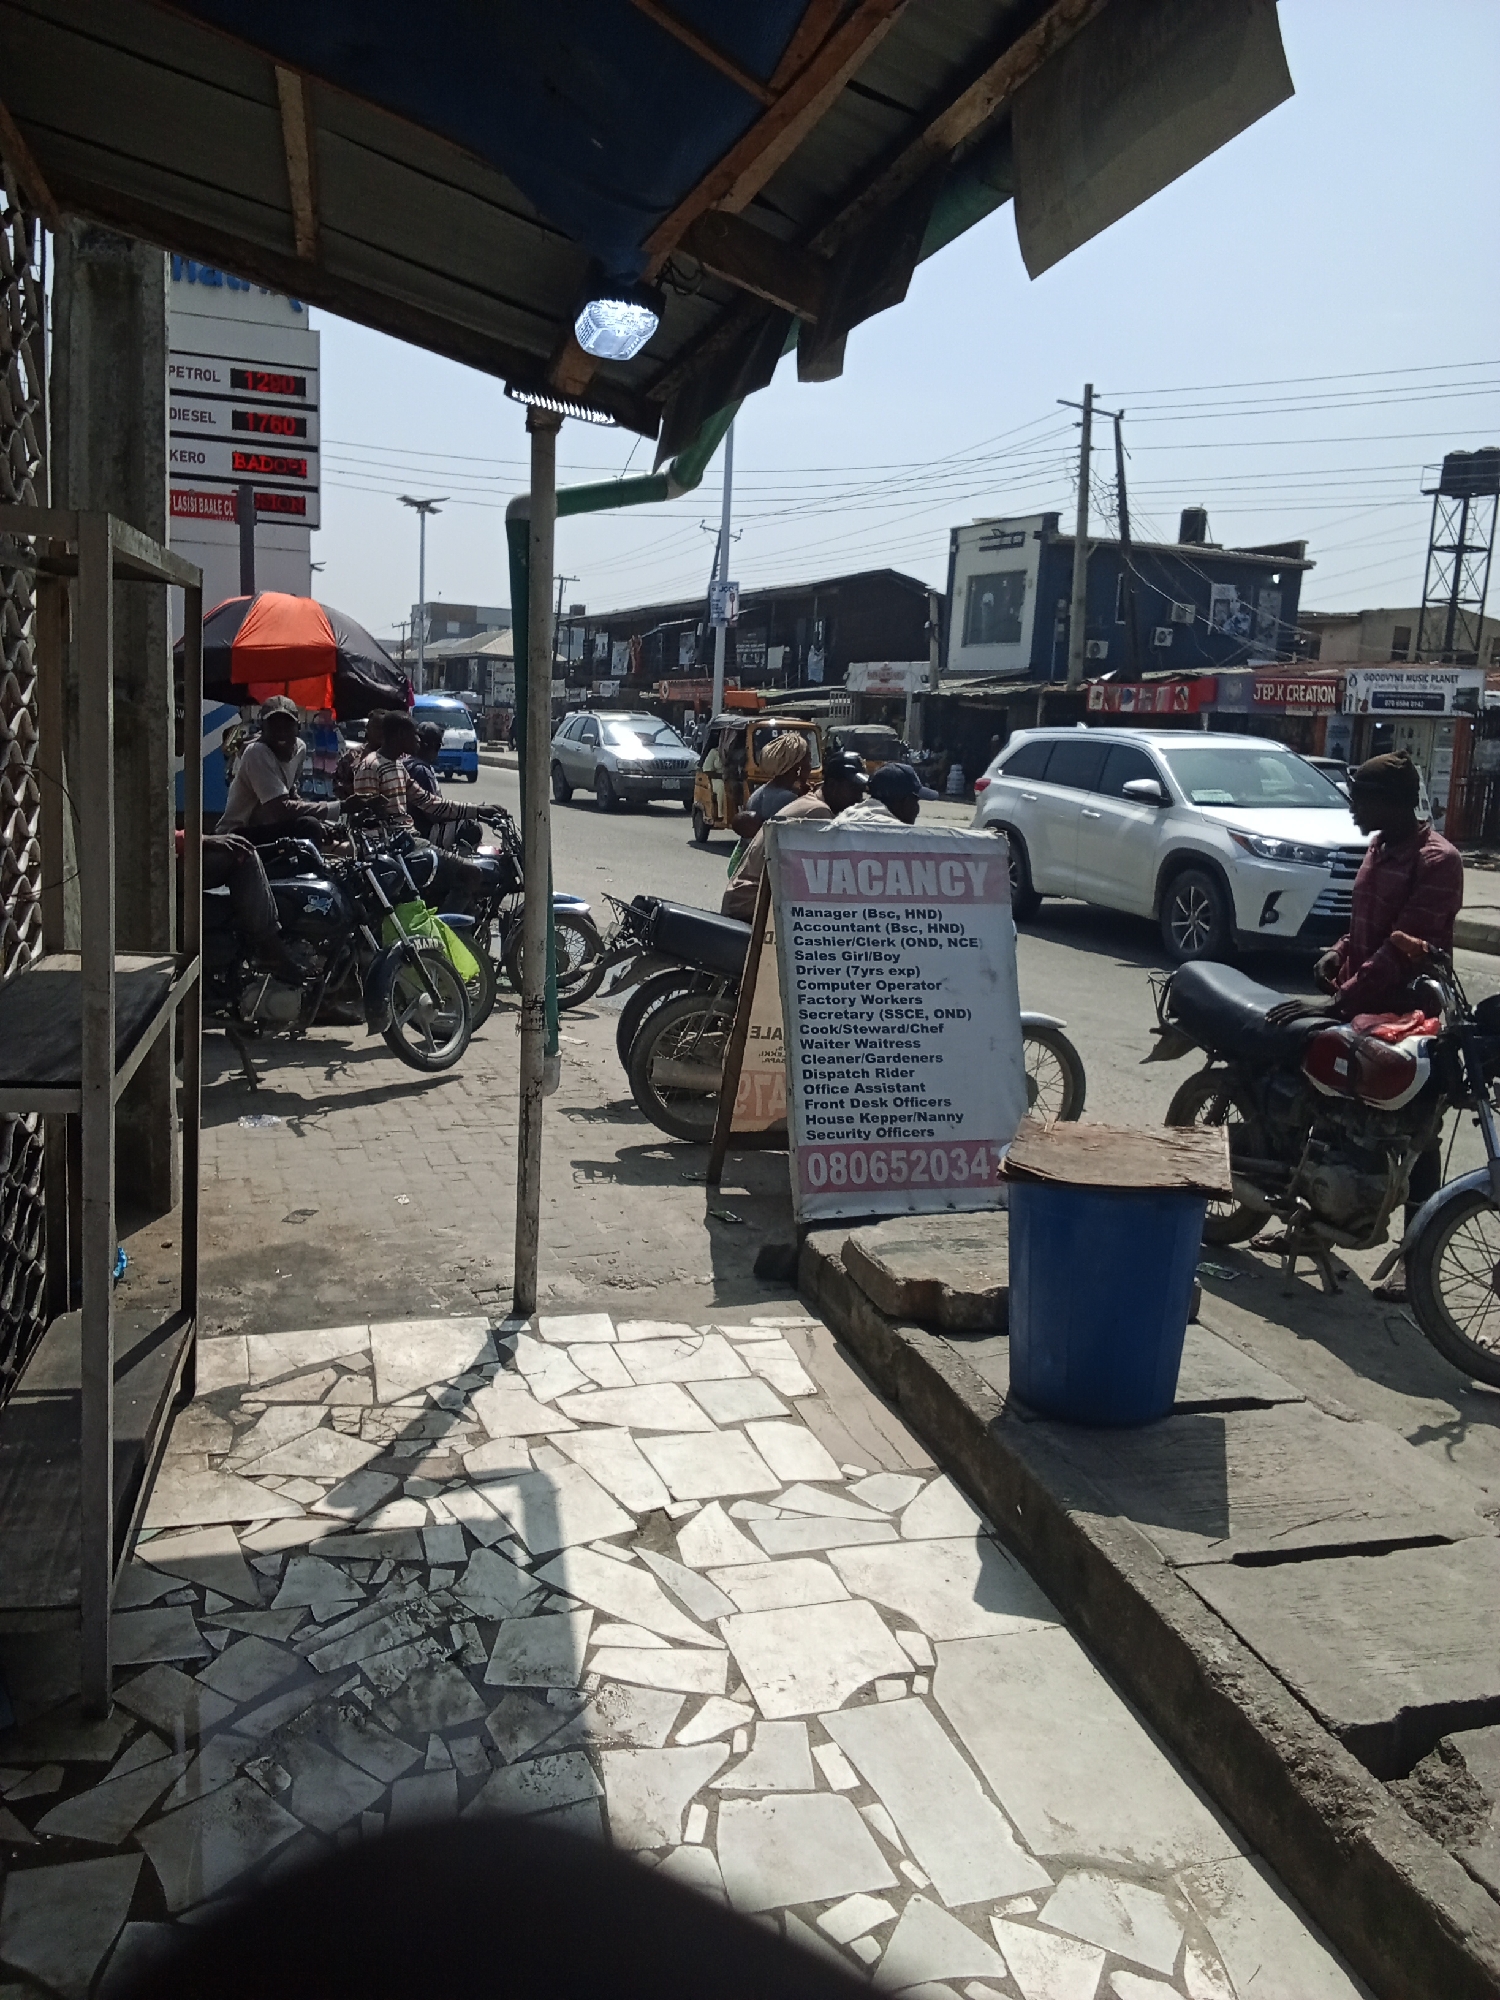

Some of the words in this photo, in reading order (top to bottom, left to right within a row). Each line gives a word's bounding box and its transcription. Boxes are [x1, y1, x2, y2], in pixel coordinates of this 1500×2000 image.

[169, 365, 220, 382] PETROL
[170, 407, 216, 424] DIESEL
[247, 412, 296, 436] 1760
[170, 449, 205, 463] KERO
[173, 496, 197, 512] LASISI
[199, 498, 222, 514] BAALE
[1406, 674, 1429, 683] MUSIC
[1431, 675, 1459, 684] PLANET
[1287, 685, 1335, 702] CREATION
[802, 858, 988, 898] VACANCY
[791, 907, 857, 920] Manager
[863, 909, 900, 920] (Bsc,
[905, 909, 942, 921] HND)
[793, 922, 881, 932] Accountant
[886, 923, 922, 935] (Bsc,
[928, 923, 964, 936] HND)
[794, 936, 896, 947] Cashier/Clerk
[901, 938, 942, 949] (OND,
[795, 950, 836, 960] Sales
[842, 951, 900, 964] Girl/Boy
[796, 965, 841, 975] Driver
[846, 966, 884, 978] (7yrs
[889, 966, 920, 978] exp)
[797, 980, 871, 992] Computer
[876, 981, 942, 992] Operator
[798, 994, 856, 1007] Factory
[861, 995, 922, 1004] Workers
[799, 1009, 874, 1021] Secretary
[879, 1009, 928, 1021] (SSCE,
[934, 1009, 971, 1021] OND)
[800, 1023, 944, 1034] Cook/Steward/Chef
[800, 1039, 850, 1049] Waiter
[854, 1039, 920, 1048] Waitress
[801, 1053, 943, 1064] Cleaner/Gardeners
[803, 1069, 869, 1081] Dispatch
[876, 1068, 915, 1078] Rider
[803, 1084, 849, 1094] Office
[855, 1083, 925, 1093] Assistant
[805, 1099, 845, 1110] Front
[850, 1098, 888, 1108] Desk
[893, 1097, 951, 1107] Officers
[806, 1115, 854, 1125] House
[860, 1112, 963, 1125] Kepper/Nanny
[806, 1129, 871, 1140] Security
[876, 1127, 934, 1138] Officers
